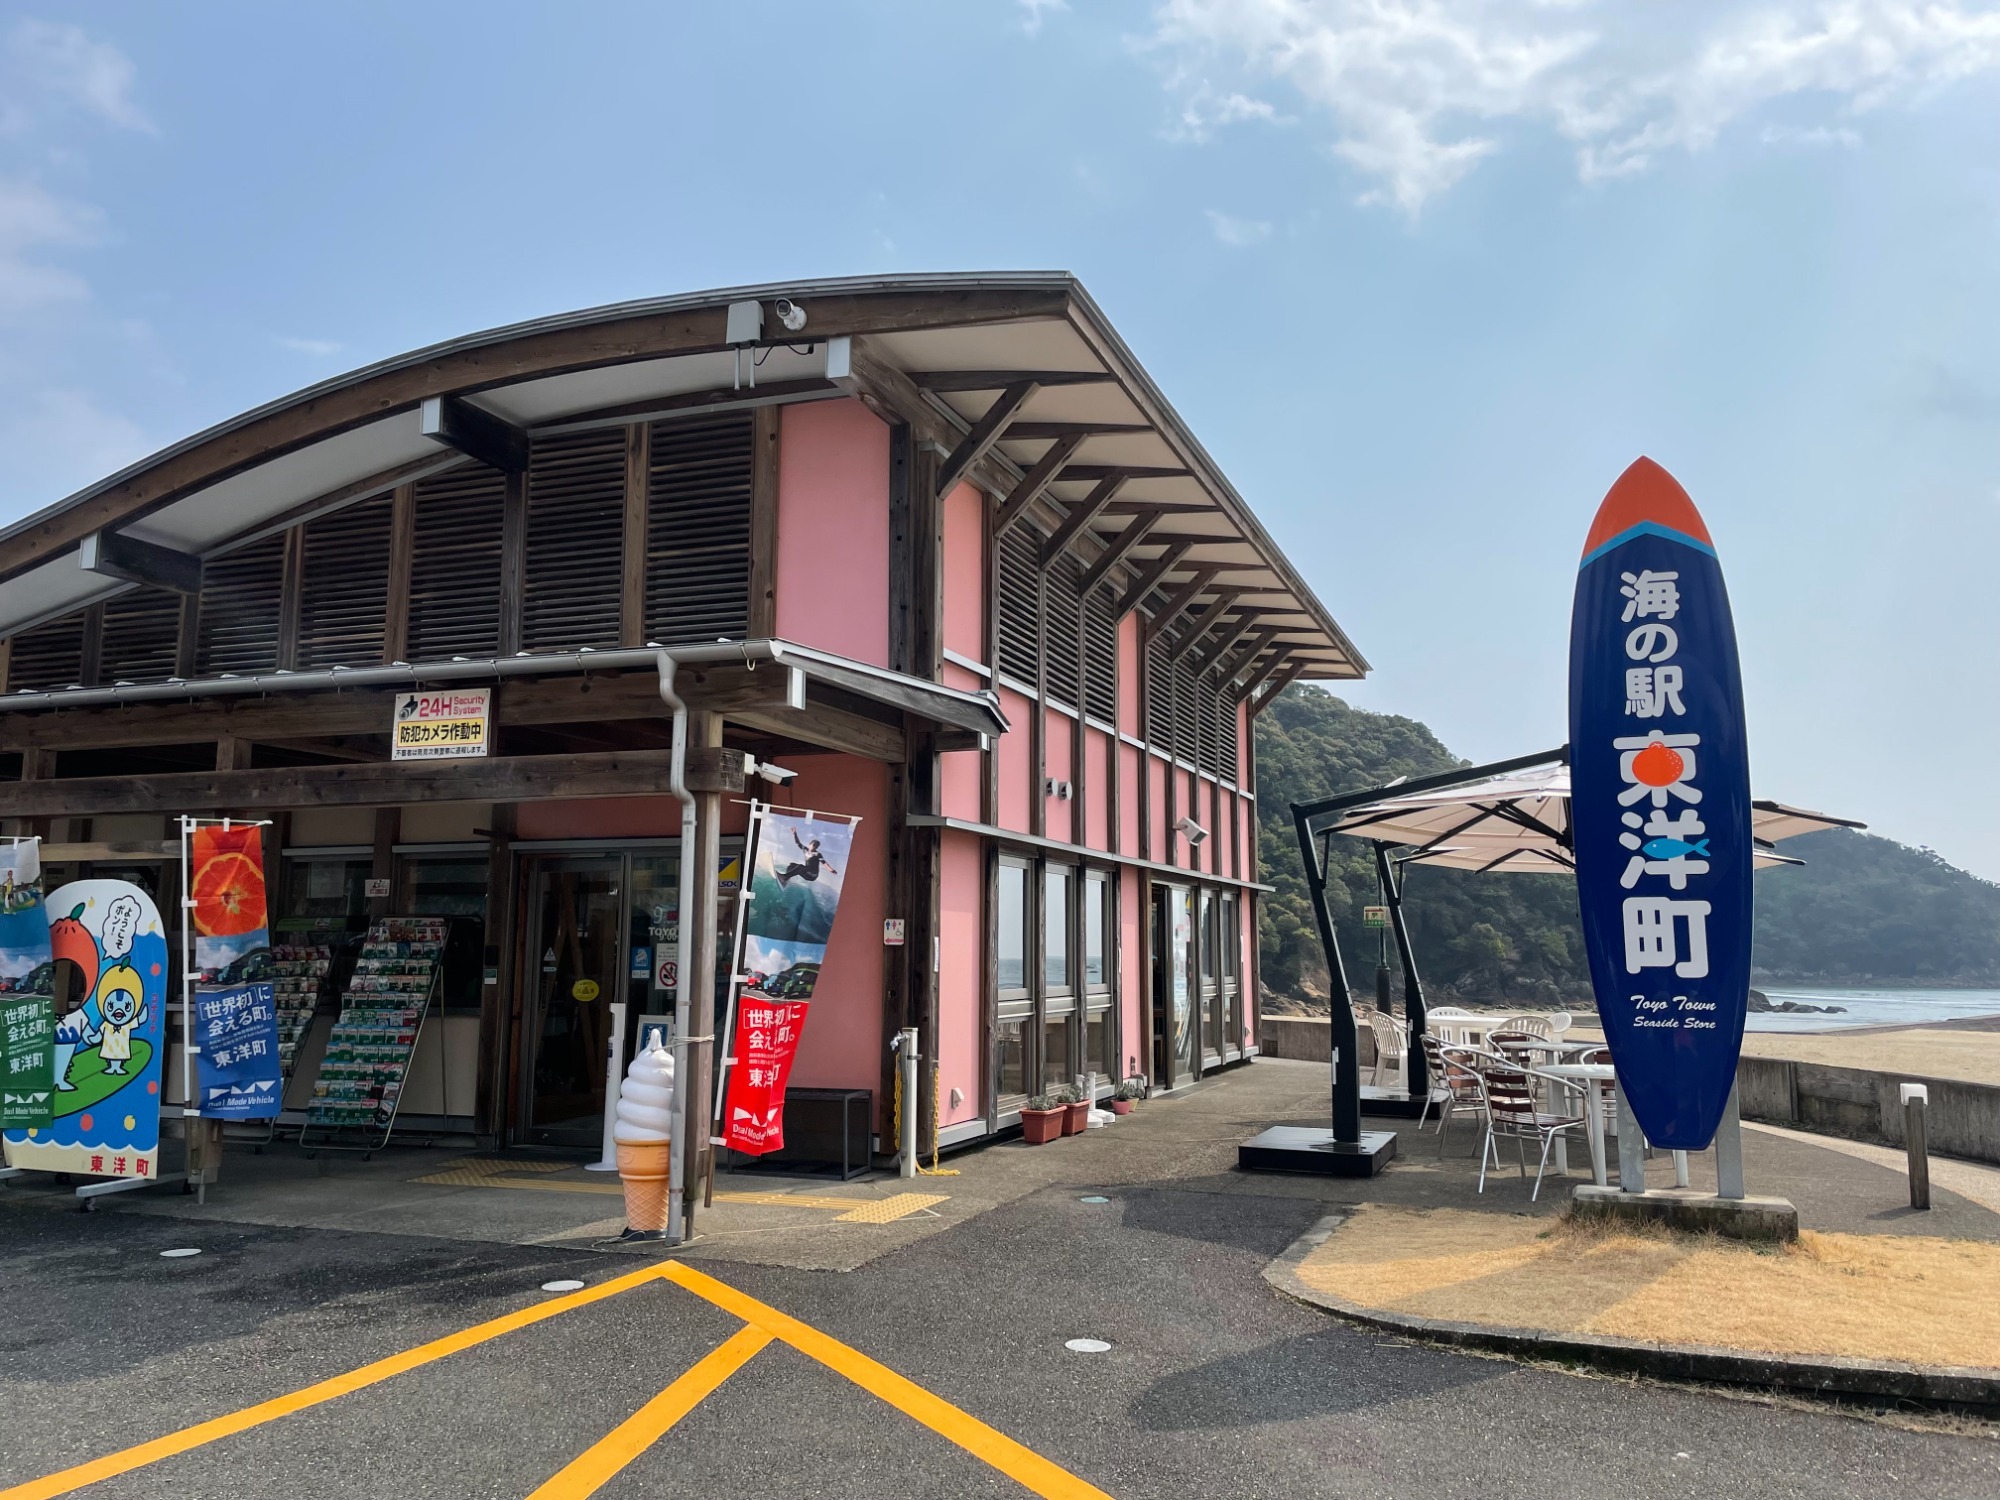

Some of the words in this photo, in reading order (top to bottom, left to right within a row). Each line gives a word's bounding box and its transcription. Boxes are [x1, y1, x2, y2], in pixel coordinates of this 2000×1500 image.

[1620, 570, 1686, 718] 海の駅
[419, 697, 452, 717] 24H
[454, 696, 485, 705] Security
[453, 706, 481, 715] System
[400, 722, 481, 744] 防犯カメラ作動中
[1613, 730, 1711, 978] 東洋町
[115, 907, 132, 950] ようこそ
[1630, 994, 1668, 1013] Toyo
[1672, 995, 1717, 1011] Town
[7, 1019, 51, 1043] 会える町。
[208, 1005, 272, 1037] 会える町。
[1633, 1016, 1679, 1028] Seaside
[1683, 1017, 1716, 1029] Store
[9, 1052, 44, 1074] 東洋町
[212, 1039, 267, 1069] 東洋町
[226, 1097, 247, 1106] Mode
[248, 1095, 275, 1105] Vehicle
[733, 1123, 748, 1135] Dual
[90, 1155, 149, 1177] 東洋町
